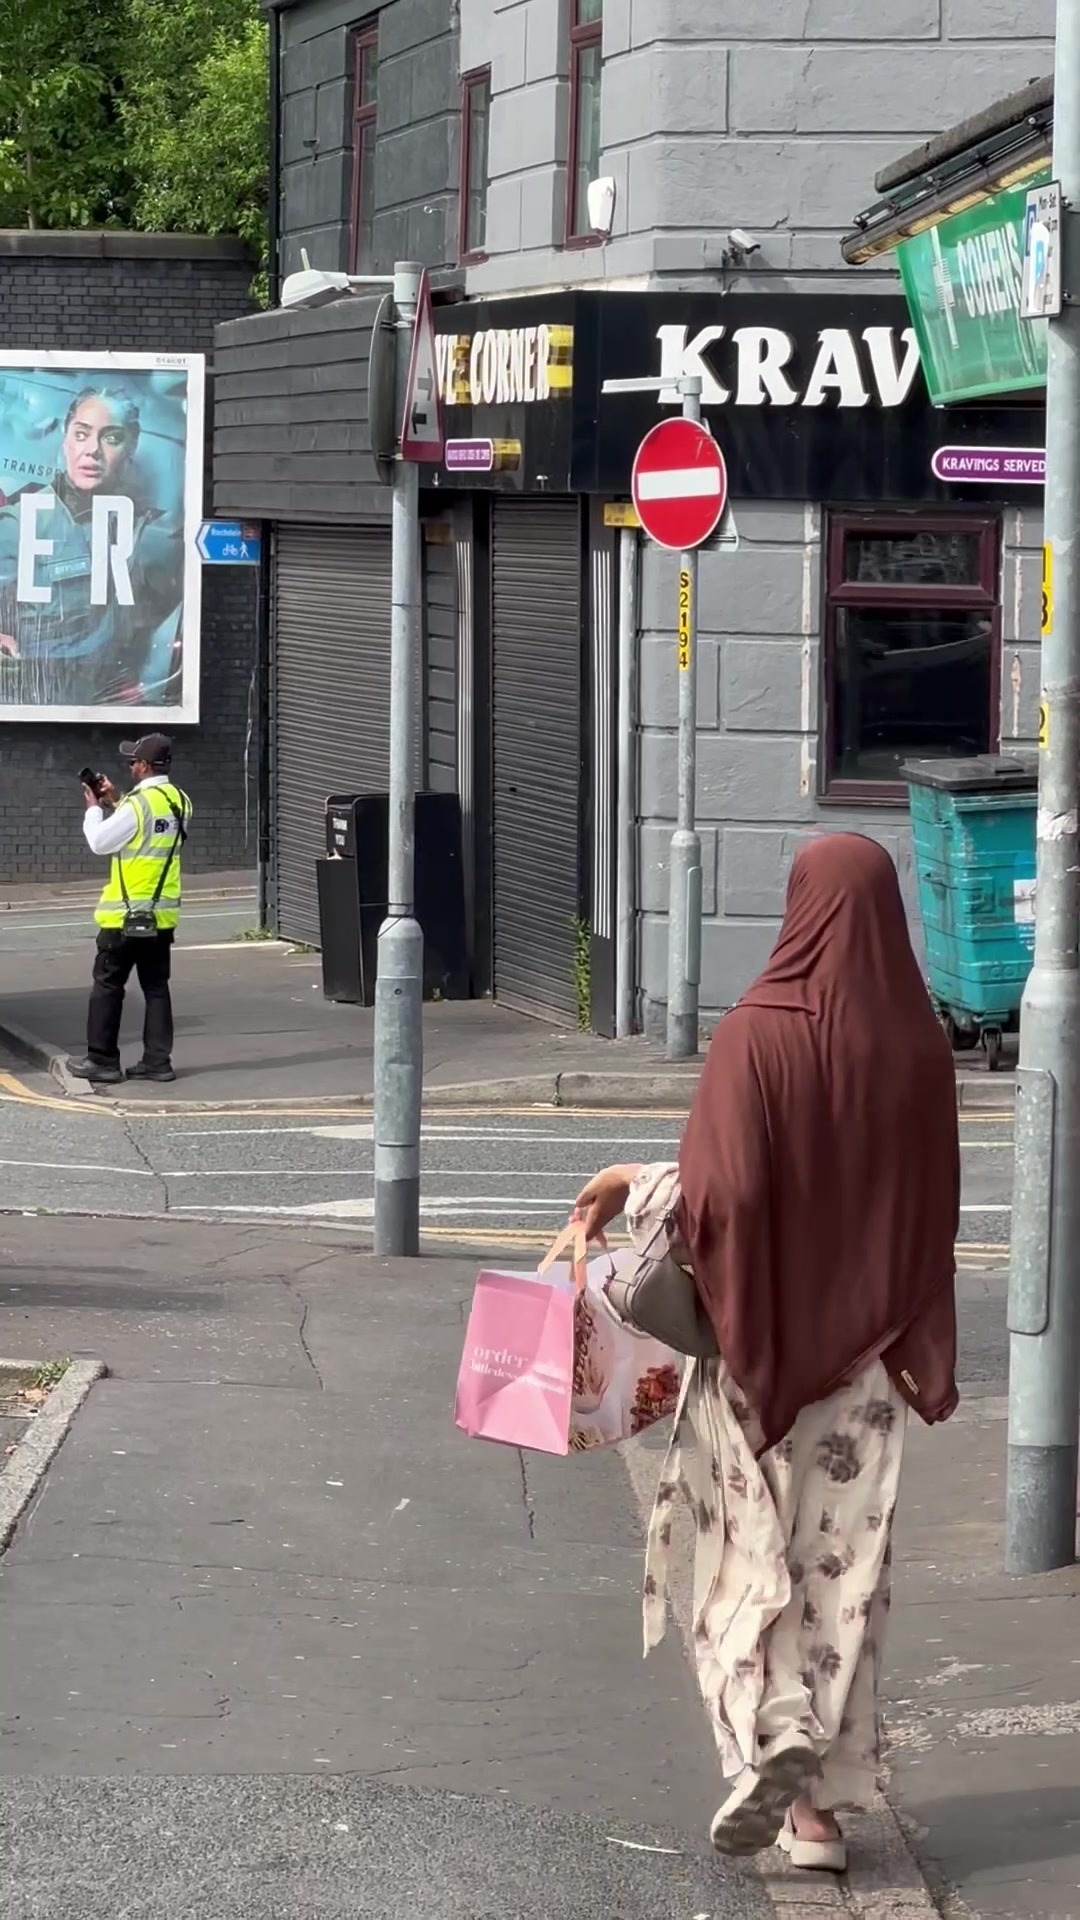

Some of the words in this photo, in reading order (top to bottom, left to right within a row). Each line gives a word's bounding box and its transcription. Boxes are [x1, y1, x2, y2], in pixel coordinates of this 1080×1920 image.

[469, 323, 550, 406] CORNER
[655, 325, 921, 407] KRAV
[942, 456, 1000, 471] KRAVINGS
[1003, 458, 1046, 473] SERVED
[679, 571, 690, 668] S2194
[473, 1346, 528, 1368] order
